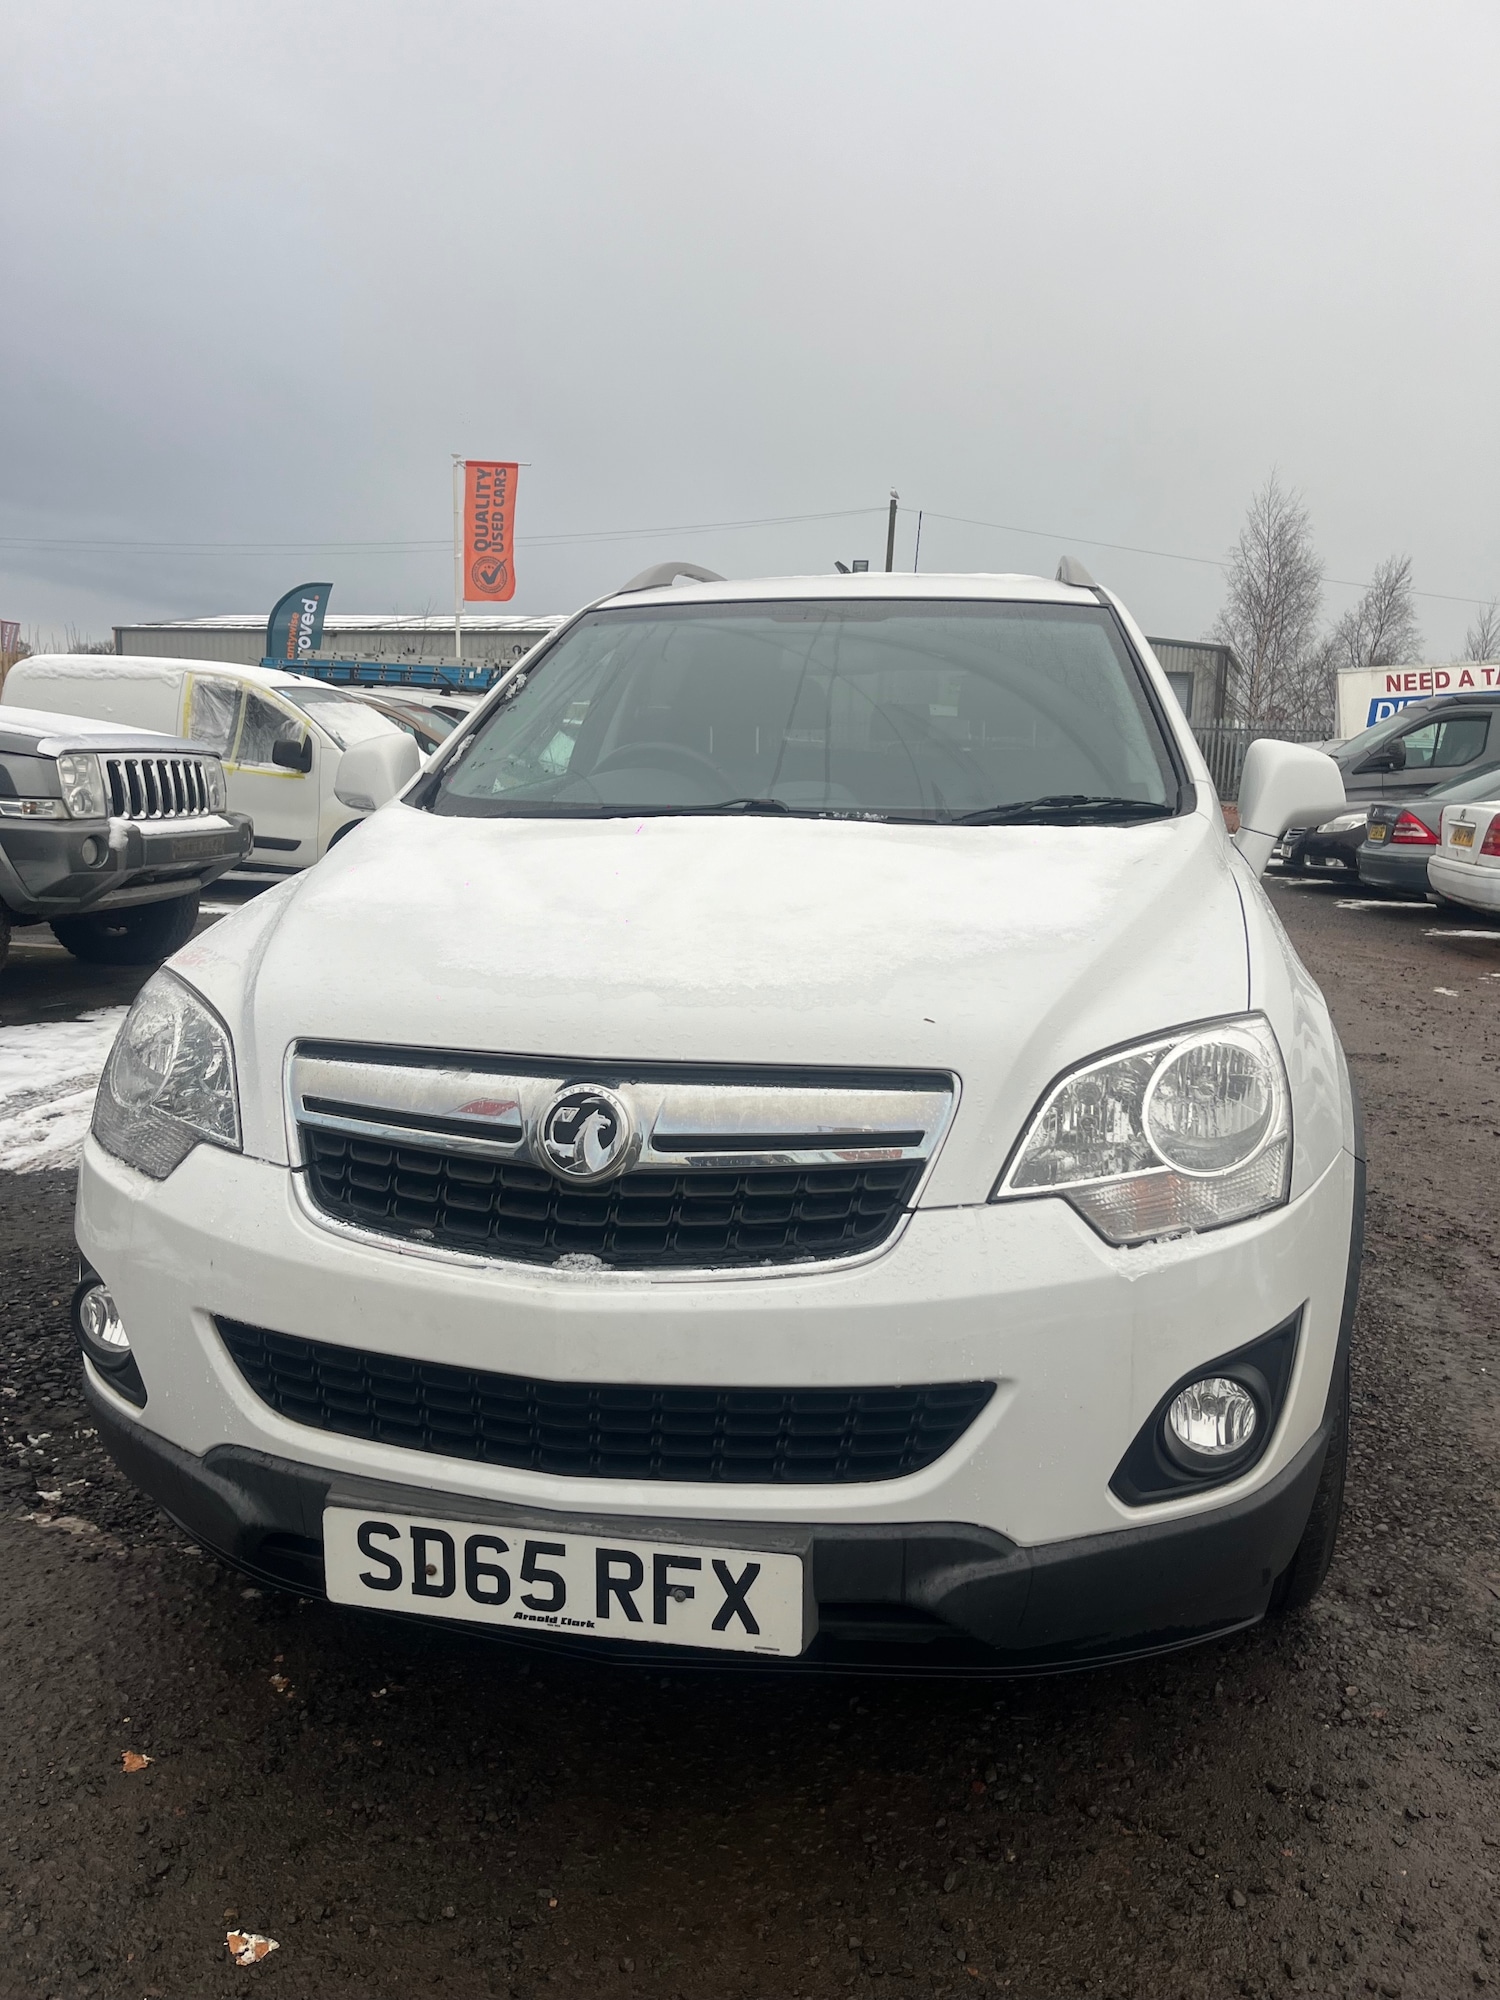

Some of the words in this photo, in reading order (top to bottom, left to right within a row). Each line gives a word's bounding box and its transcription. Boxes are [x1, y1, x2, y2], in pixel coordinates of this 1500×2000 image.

[493, 468, 507, 508] CARS
[474, 467, 492, 553] QUALITY
[492, 513, 505, 553] USED
[1386, 671, 1451, 692] NEED
[1458, 670, 1475, 688] A
[1481, 668, 1500, 686] T
[1375, 700, 1420, 723] DI
[552, 1087, 619, 1108] VAUXHALL
[357, 1520, 567, 1612] SD65
[595, 1547, 761, 1635] RFX
[513, 1611, 558, 1624] Arnold
[560, 1617, 595, 1629] Clark
